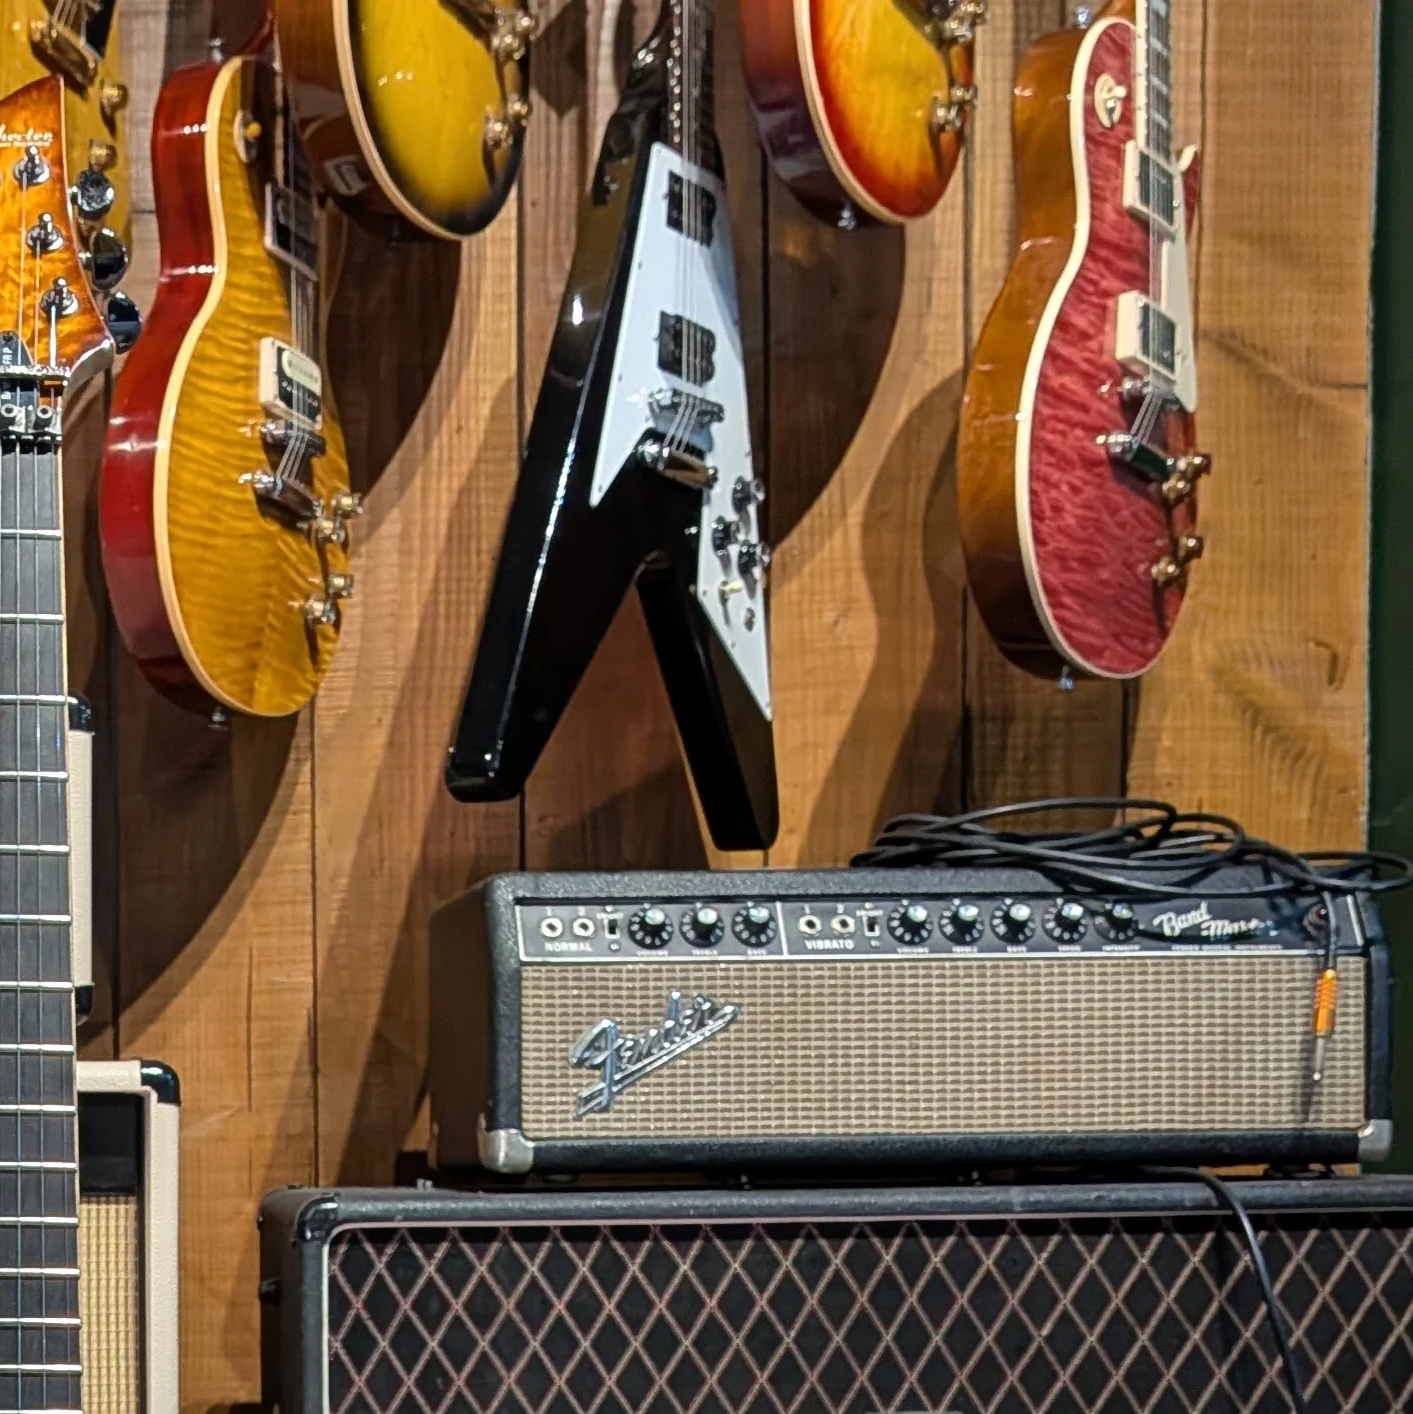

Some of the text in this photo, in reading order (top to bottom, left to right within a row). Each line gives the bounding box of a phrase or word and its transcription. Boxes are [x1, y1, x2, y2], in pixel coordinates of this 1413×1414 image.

[1152, 901, 1212, 937] Band
[544, 941, 593, 953] NORMAL
[804, 939, 855, 951] VIBRATO
[568, 987, 743, 1120] Fender
